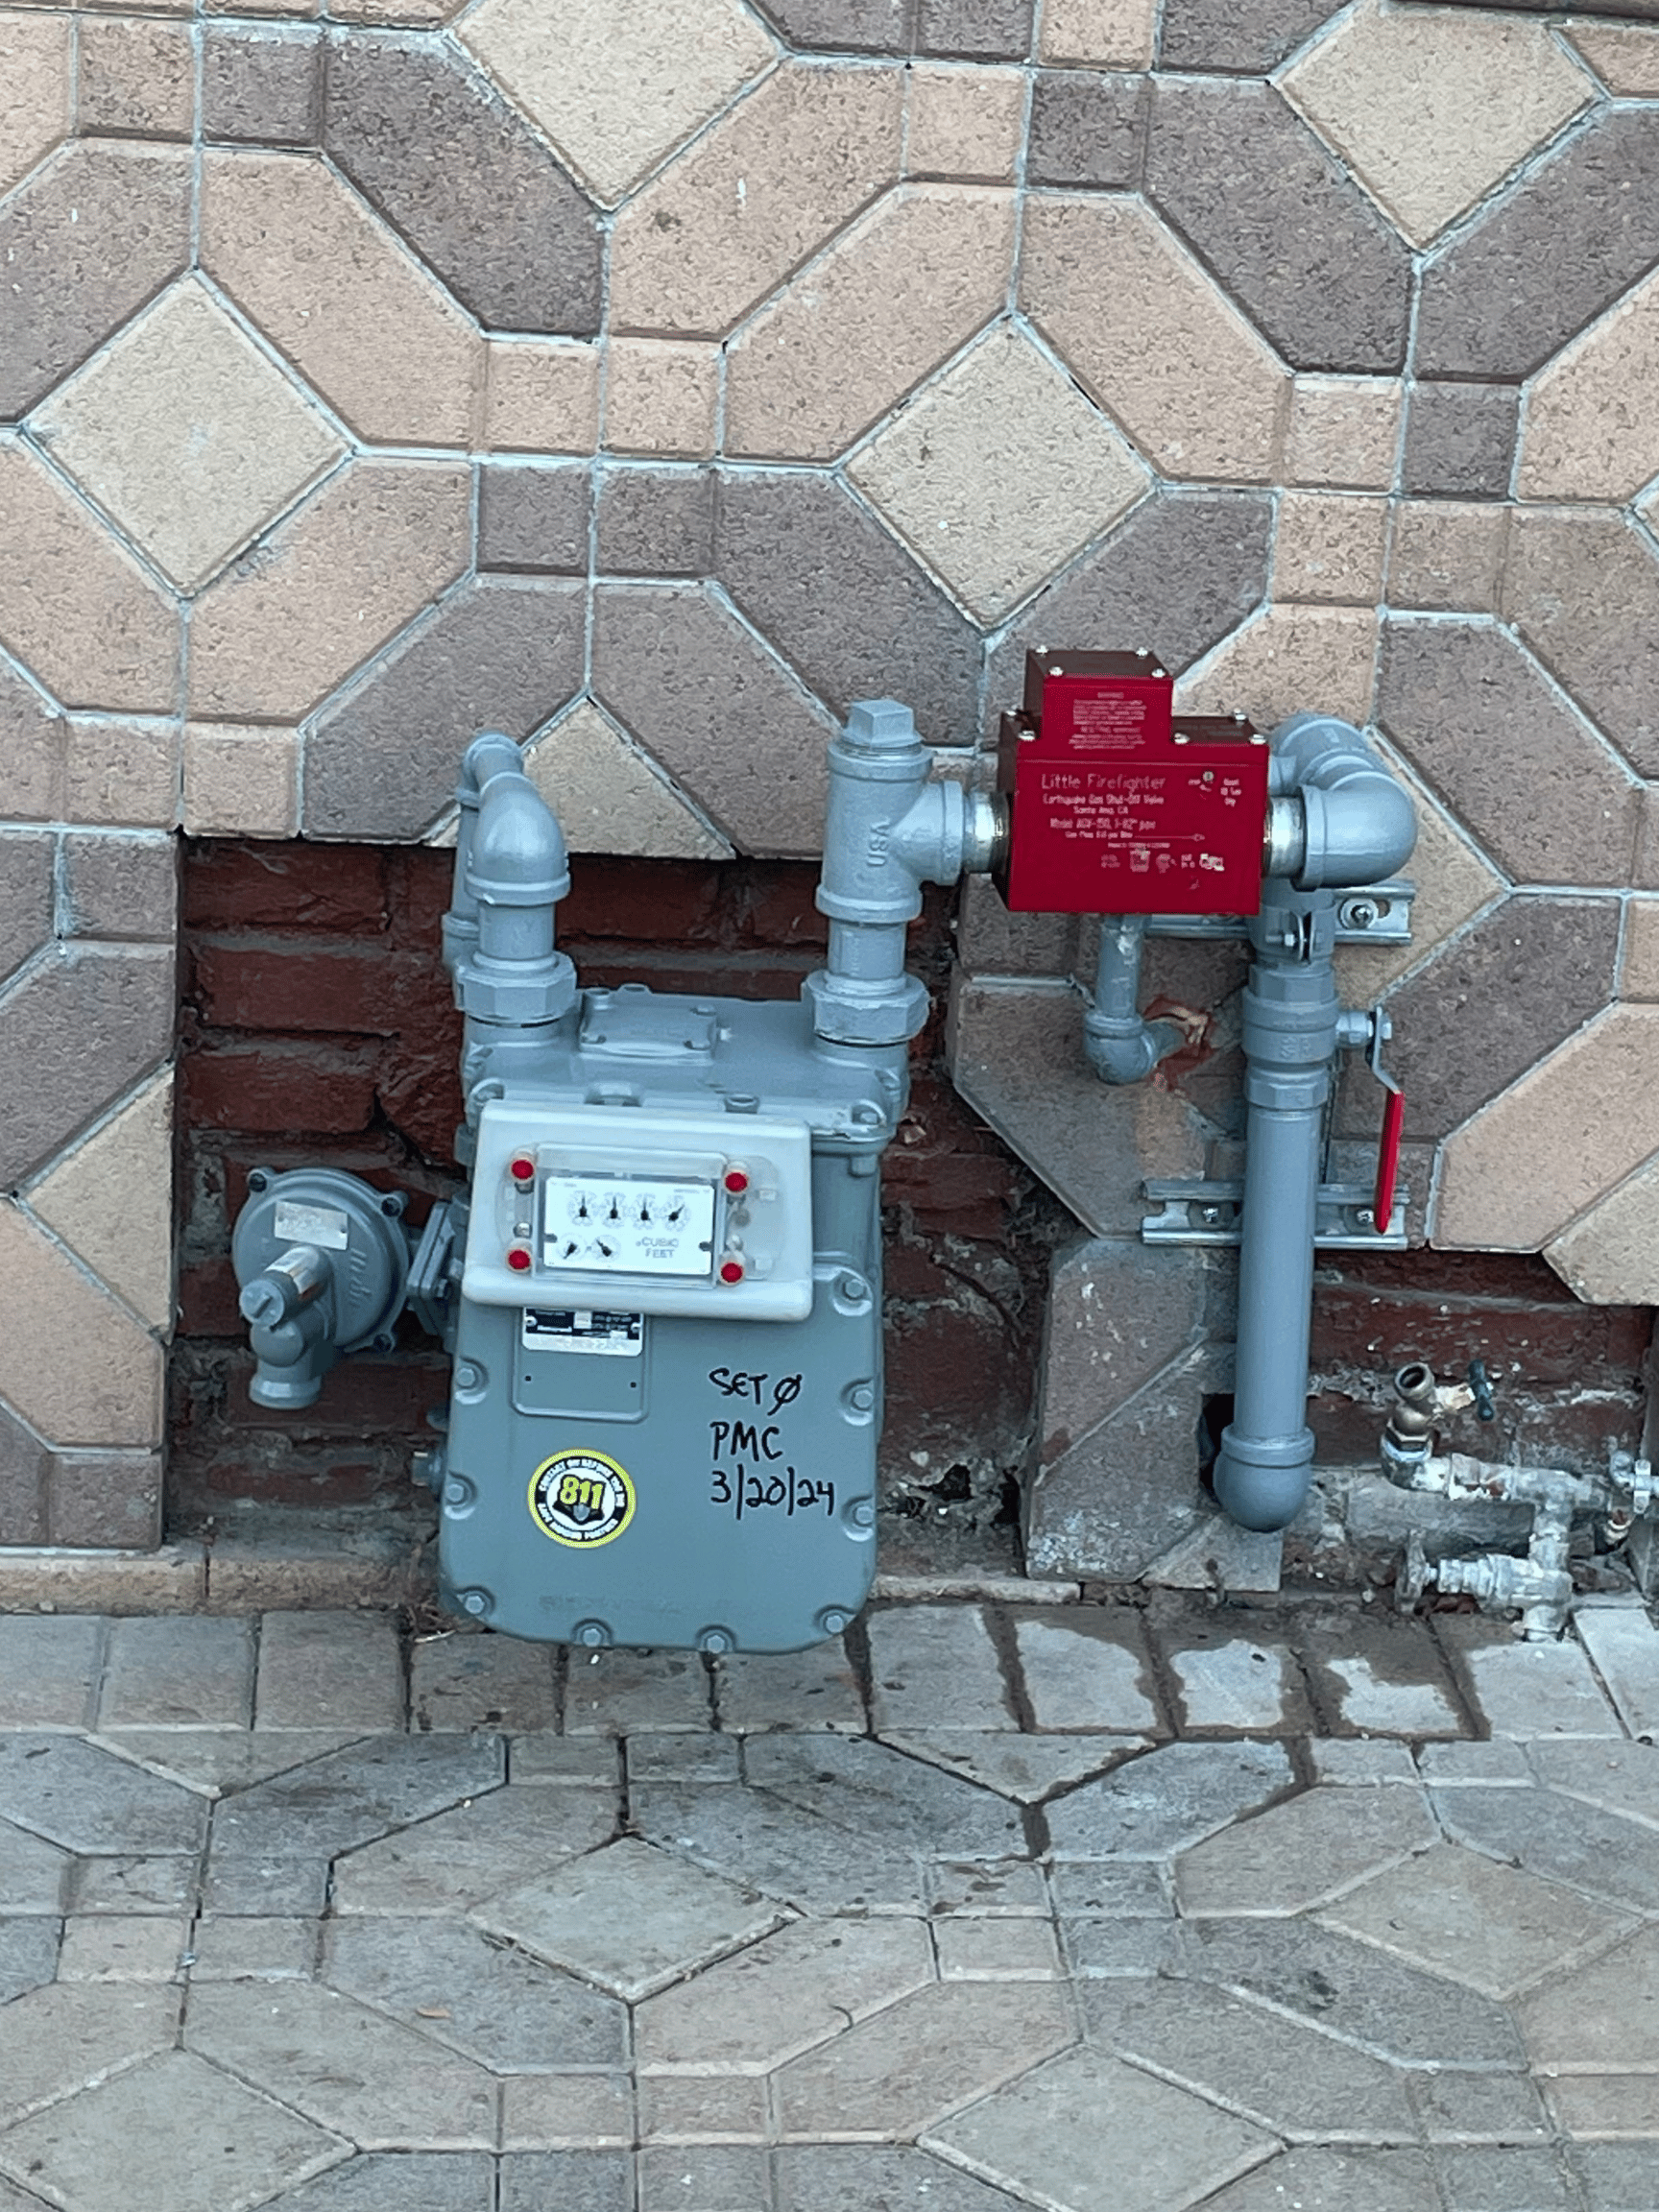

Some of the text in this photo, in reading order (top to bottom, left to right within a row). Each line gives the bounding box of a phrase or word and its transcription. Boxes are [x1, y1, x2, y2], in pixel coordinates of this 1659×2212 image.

[1042, 772, 1166, 793] Little Firefighter
[642, 1237, 680, 1247] CUBIC
[645, 1248, 676, 1258] FEET
[709, 1367, 768, 1406] SET
[709, 1420, 783, 1461] PMC
[560, 1476, 604, 1509] 811
[710, 1463, 835, 1521] 3/20/24
